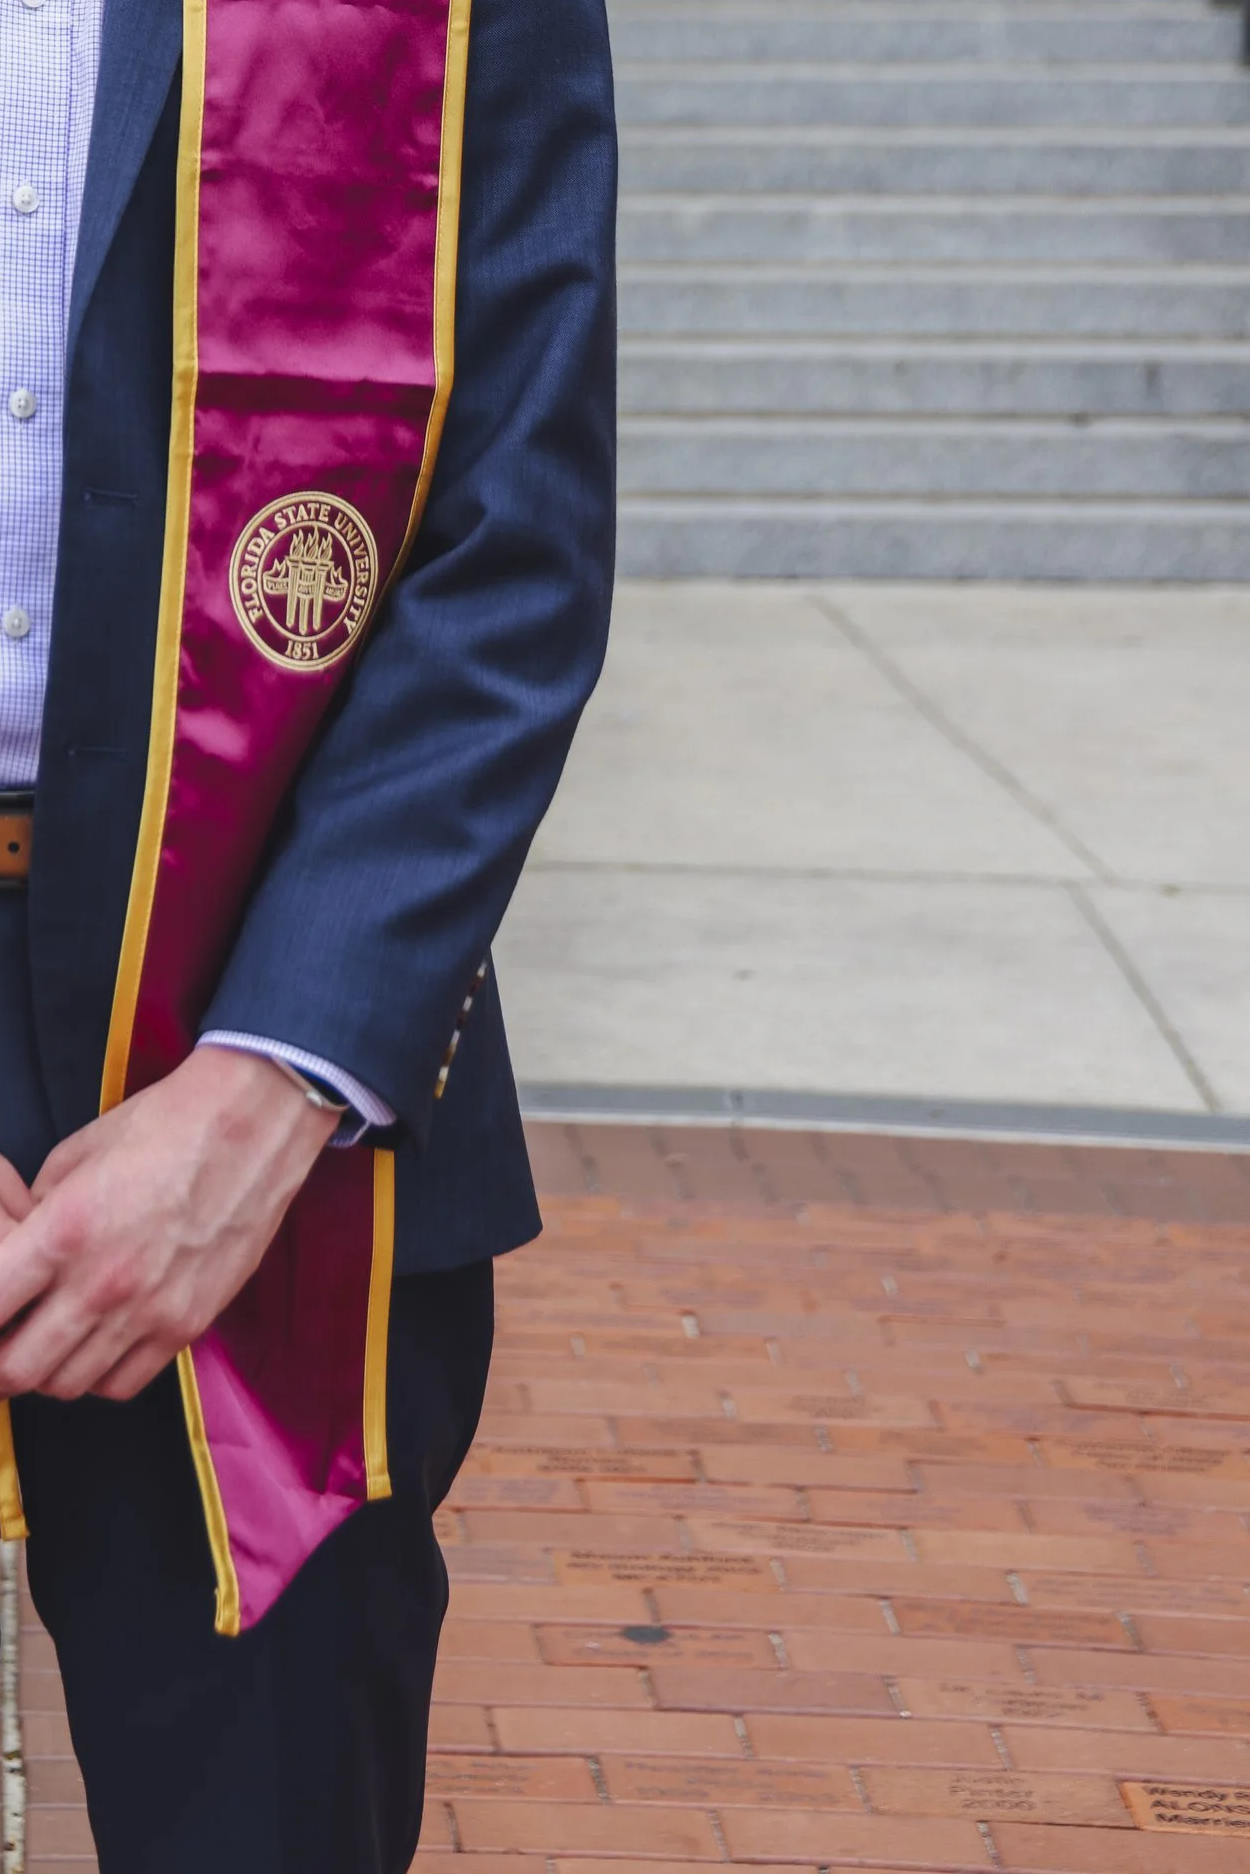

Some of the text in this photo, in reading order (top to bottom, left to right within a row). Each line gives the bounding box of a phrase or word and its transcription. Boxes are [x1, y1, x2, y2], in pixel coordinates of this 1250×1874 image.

[241, 502, 369, 634] FLORIDA STATE UNIVERSITY
[284, 640, 319, 660] 1851
[1154, 1813, 1250, 1828] Marrie
